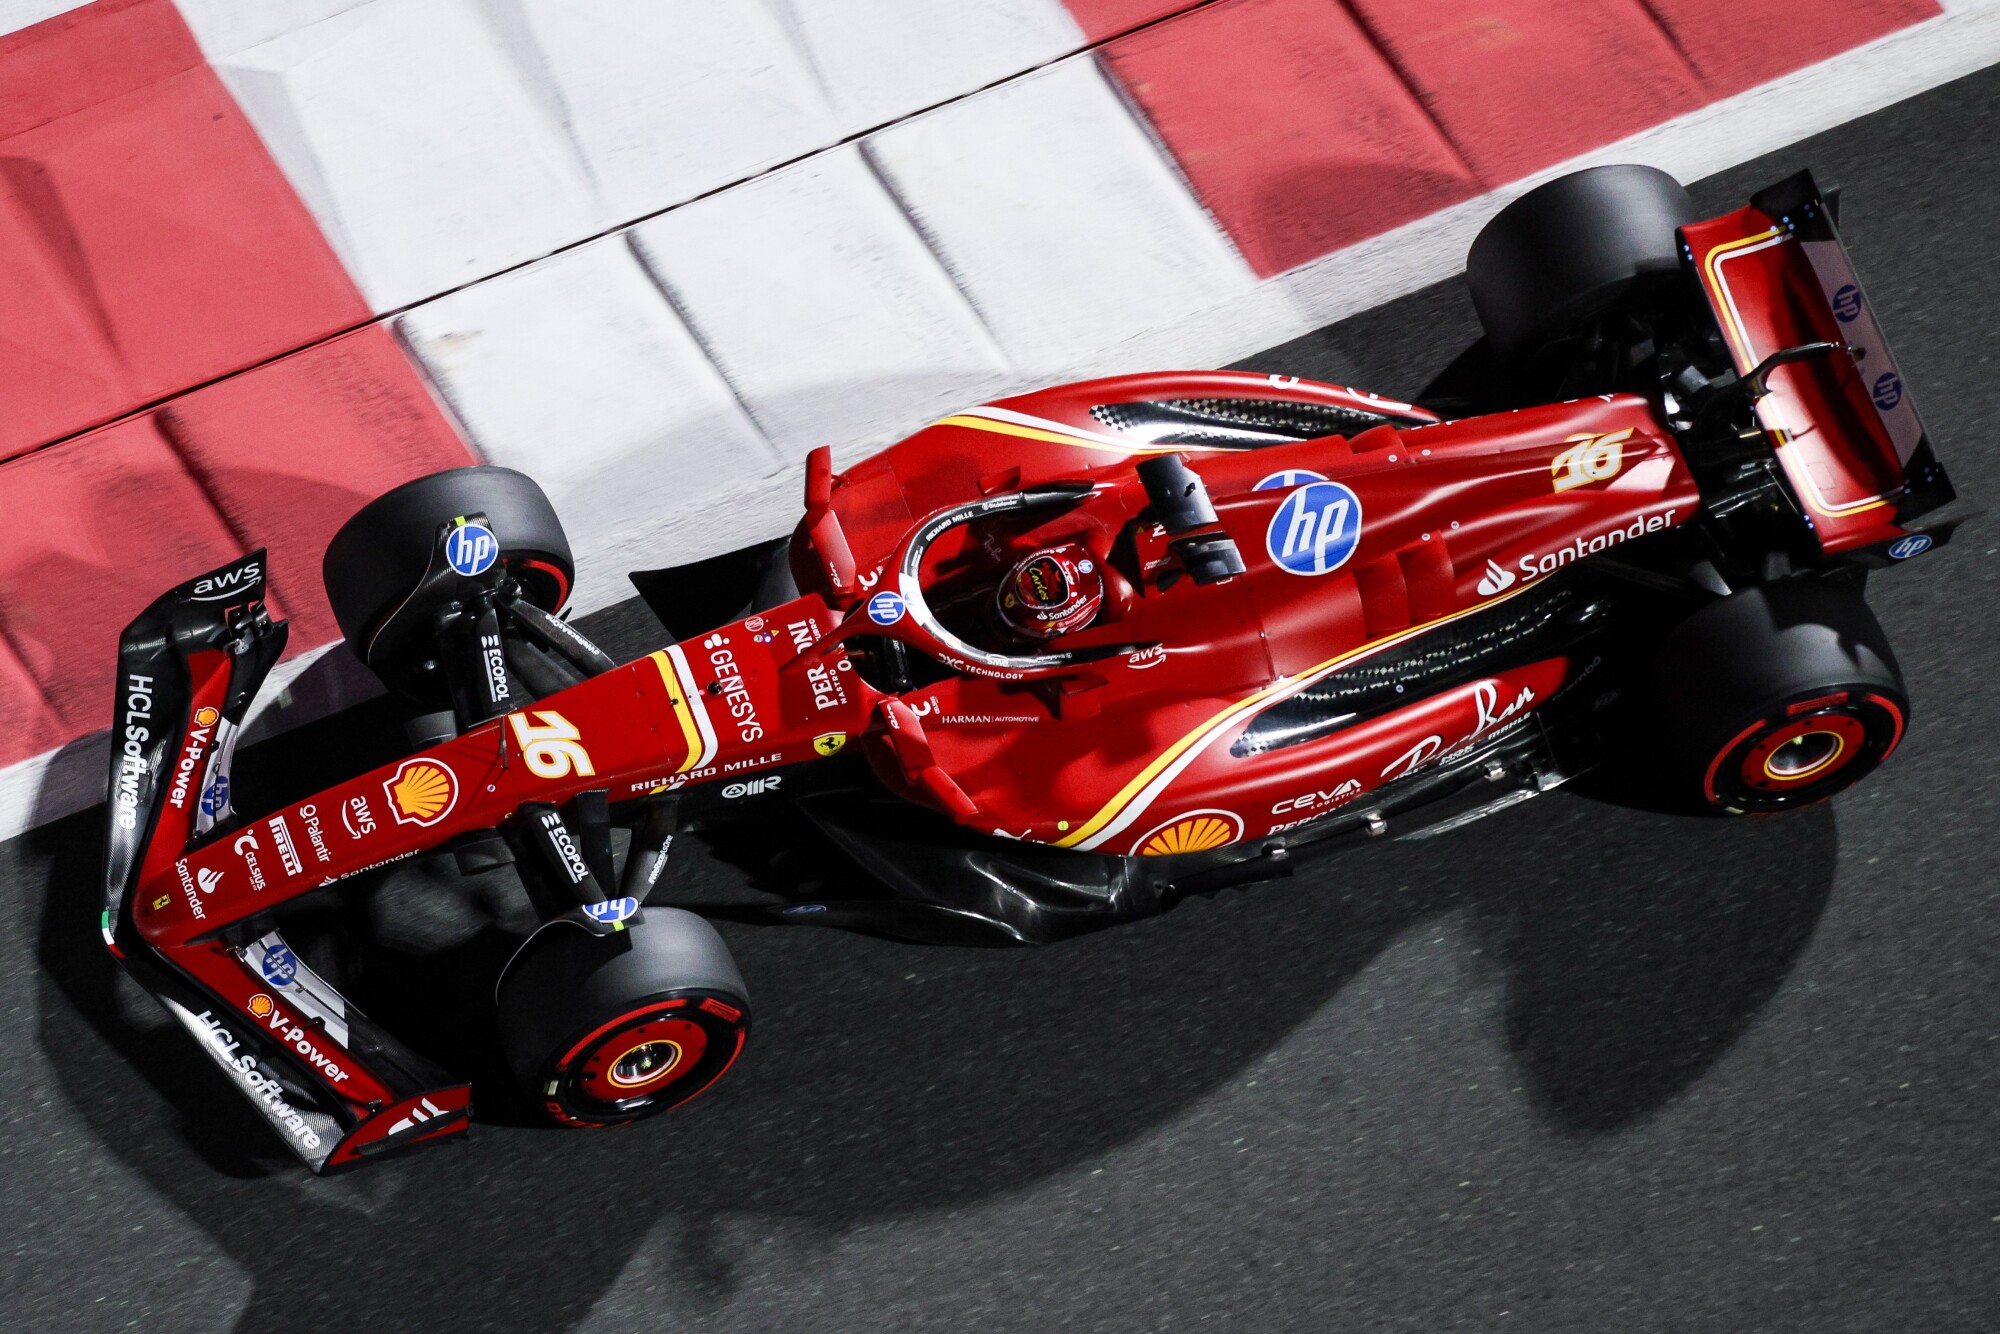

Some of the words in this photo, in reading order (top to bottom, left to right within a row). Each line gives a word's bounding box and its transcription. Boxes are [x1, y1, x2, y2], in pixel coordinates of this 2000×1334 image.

[1834, 287, 1860, 318] hp
[1873, 376, 1900, 406] hp
[1551, 427, 1635, 494] 16
[925, 518, 952, 542] RICHARD
[952, 510, 975, 523] MILLE
[1281, 483, 1351, 575] hp
[1518, 508, 1676, 582] Santander
[453, 525, 493, 575] hp
[1891, 536, 1930, 558] hp
[193, 561, 261, 595] aws
[869, 595, 905, 620] hp
[1048, 595, 1088, 620] Santander
[965, 664, 1024, 680] TECHNOLOGY
[1128, 643, 1164, 665] aws
[489, 648, 510, 702] ECOPOL
[830, 669, 848, 705] NASTRO
[710, 649, 764, 743] GENESYS
[942, 715, 991, 723] HARMAN
[118, 673, 153, 830] HCLSoftware
[508, 710, 596, 778] 16
[169, 728, 210, 809] V-Power
[631, 766, 717, 793] RICHARD
[724, 753, 782, 772] MILLE
[350, 795, 377, 835] aws
[1310, 788, 1362, 810] LOGISTICS
[268, 815, 303, 877] PIRELLI
[305, 818, 332, 862] Palantir
[553, 826, 591, 882] ECOPOL
[245, 852, 266, 891] CELSIUS
[340, 849, 421, 879] Santander
[175, 858, 206, 920] Santander
[268, 1009, 349, 1084] V-Power
